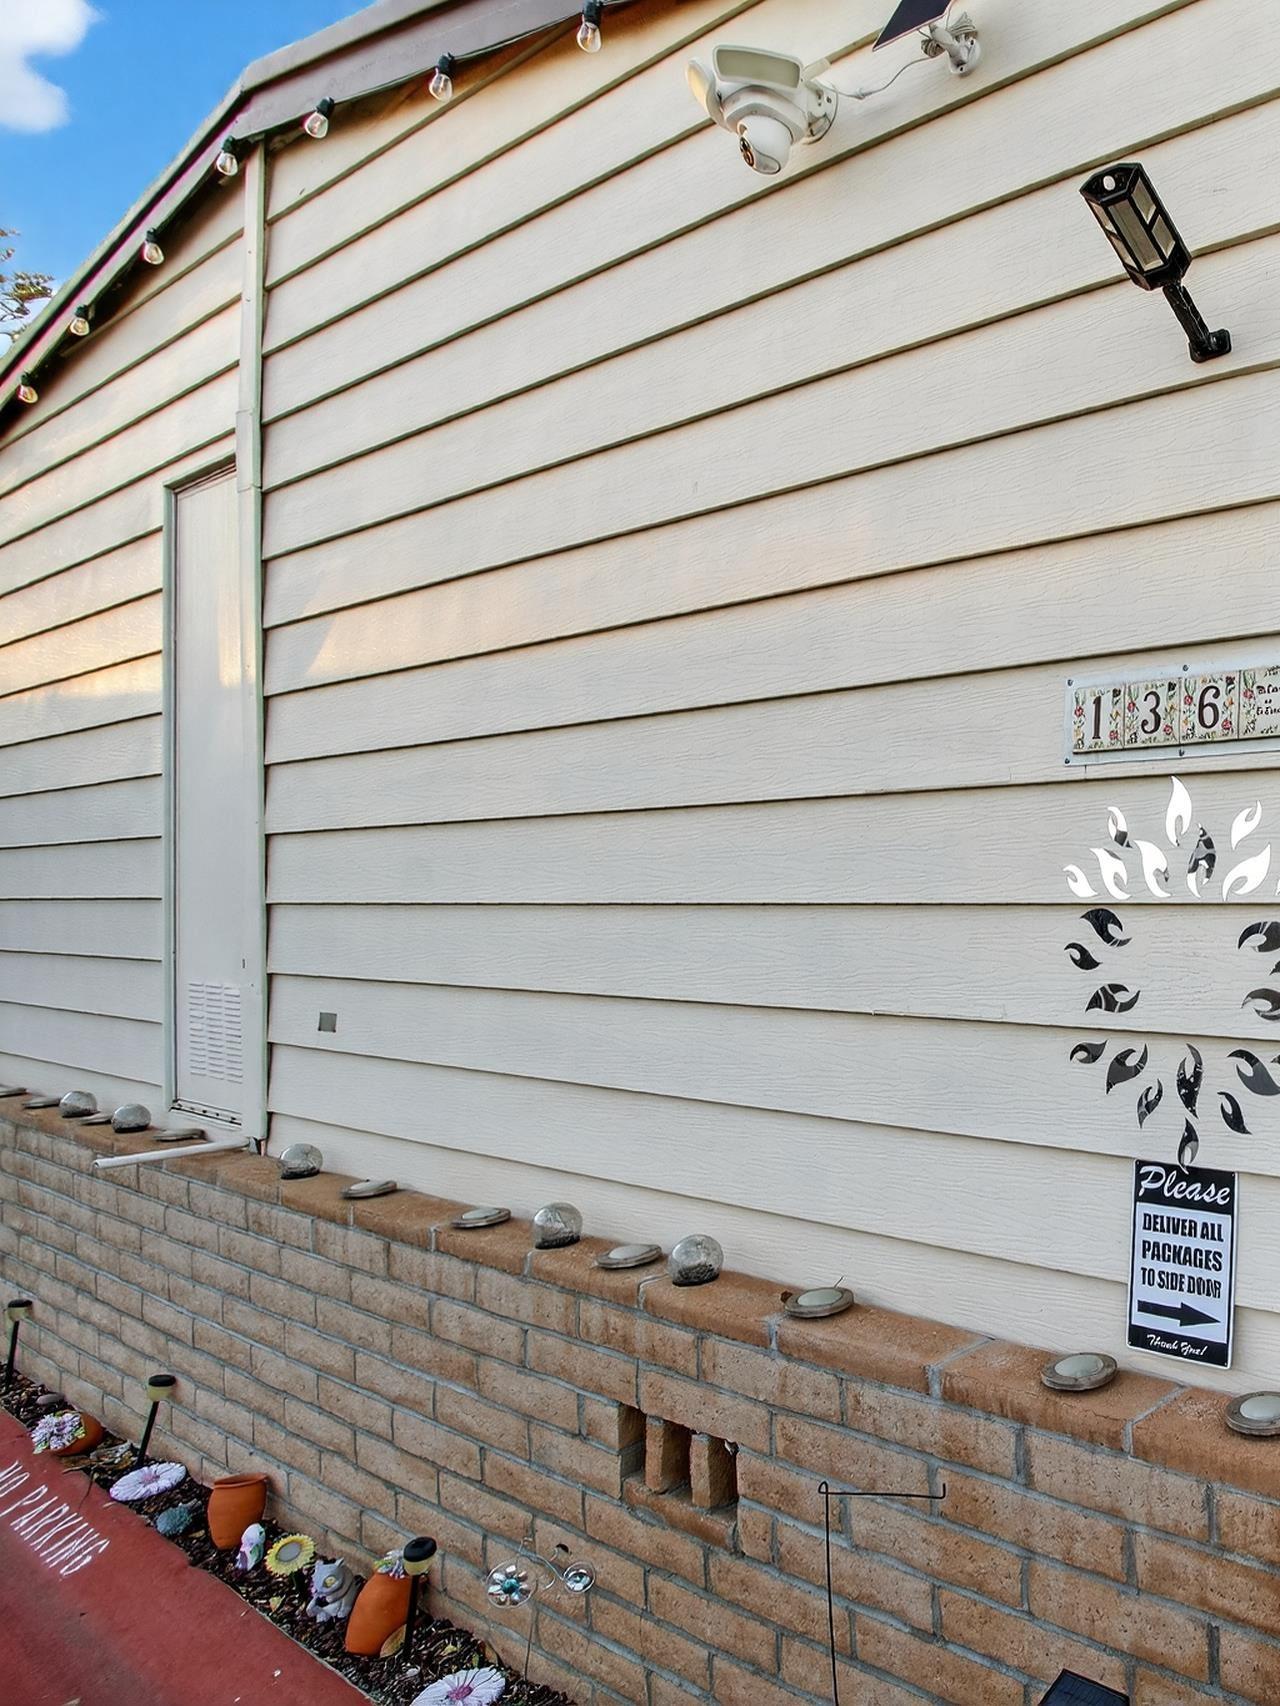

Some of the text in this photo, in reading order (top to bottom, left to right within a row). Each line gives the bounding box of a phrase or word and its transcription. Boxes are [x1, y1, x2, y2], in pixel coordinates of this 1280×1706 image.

[1091, 685, 1221, 740] 136
[1139, 1165, 1231, 1206] Please
[1142, 1212, 1224, 1243] DELIVER ALL
[1141, 1240, 1223, 1272] PACKAGES
[1140, 1267, 1221, 1299] TO SIDE DOOR
[1146, 1334, 1178, 1350] Thank
[0, 1484, 110, 1576] PARKING
